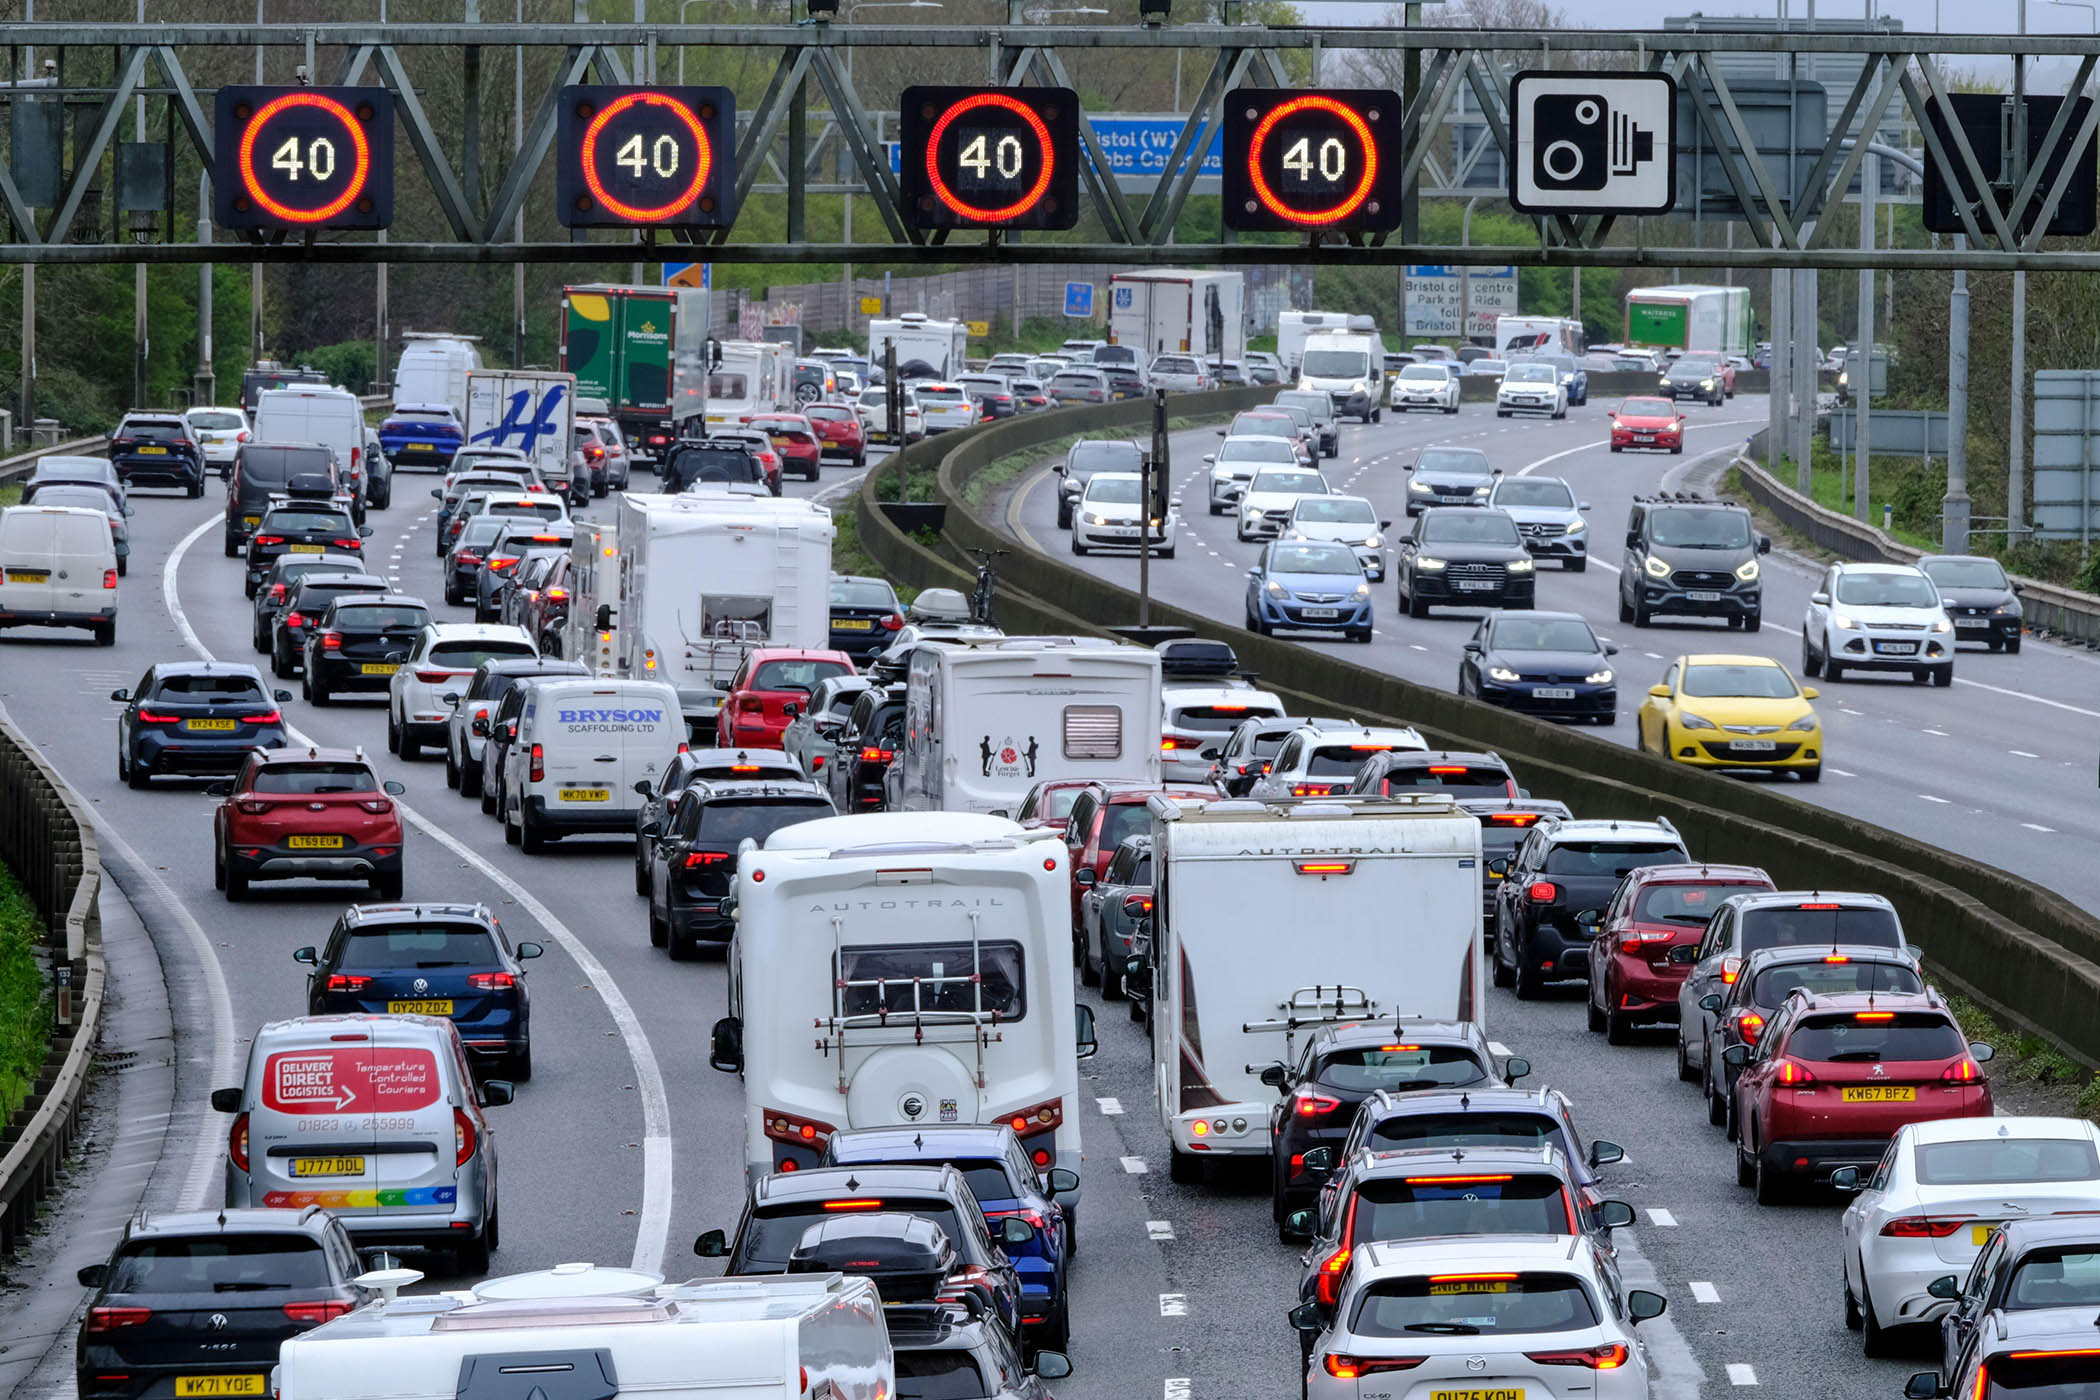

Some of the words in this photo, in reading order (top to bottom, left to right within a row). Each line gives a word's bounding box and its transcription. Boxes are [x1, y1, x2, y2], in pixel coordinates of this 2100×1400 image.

[272, 136, 336, 180] 40
[617, 134, 679, 178] 40
[959, 136, 1023, 179] 40
[1283, 137, 1347, 181] 40
[1406, 281, 1445, 292] Bristol
[1475, 283, 1514, 293] centre
[1417, 295, 1444, 305] Park
[1475, 296, 1501, 306] Ride
[1441, 307, 1477, 318] follw
[1416, 320, 1456, 331] Bristol
[627, 330, 669, 340] Morrisons
[558, 709, 663, 723] BRYSON
[568, 724, 634, 733] SCAFFOLDING
[637, 724, 655, 733] LTD
[563, 789, 587, 800] MK70
[292, 837, 318, 846] LT69
[1239, 847, 1414, 856] AUTO-TRAIL
[810, 898, 1004, 913] AUTOTRAIL
[425, 1002, 448, 1013] ZDZ
[282, 1062, 334, 1073] DELIVERY
[355, 1061, 425, 1073] Temperature
[282, 1072, 334, 1087] DIRECT
[368, 1072, 426, 1083] Controlled
[282, 1086, 334, 1097] LOGISTICS
[377, 1083, 426, 1094] Couriers
[1848, 1088, 1881, 1100] KW67
[1884, 1088, 1910, 1099] BFZ
[297, 1119, 339, 1132] 01823
[362, 1118, 415, 1131] 255999
[299, 1159, 332, 1173] J777
[336, 1158, 362, 1172] DDL
[186, 1378, 219, 1392] WK71
[223, 1377, 254, 1391] YOE
